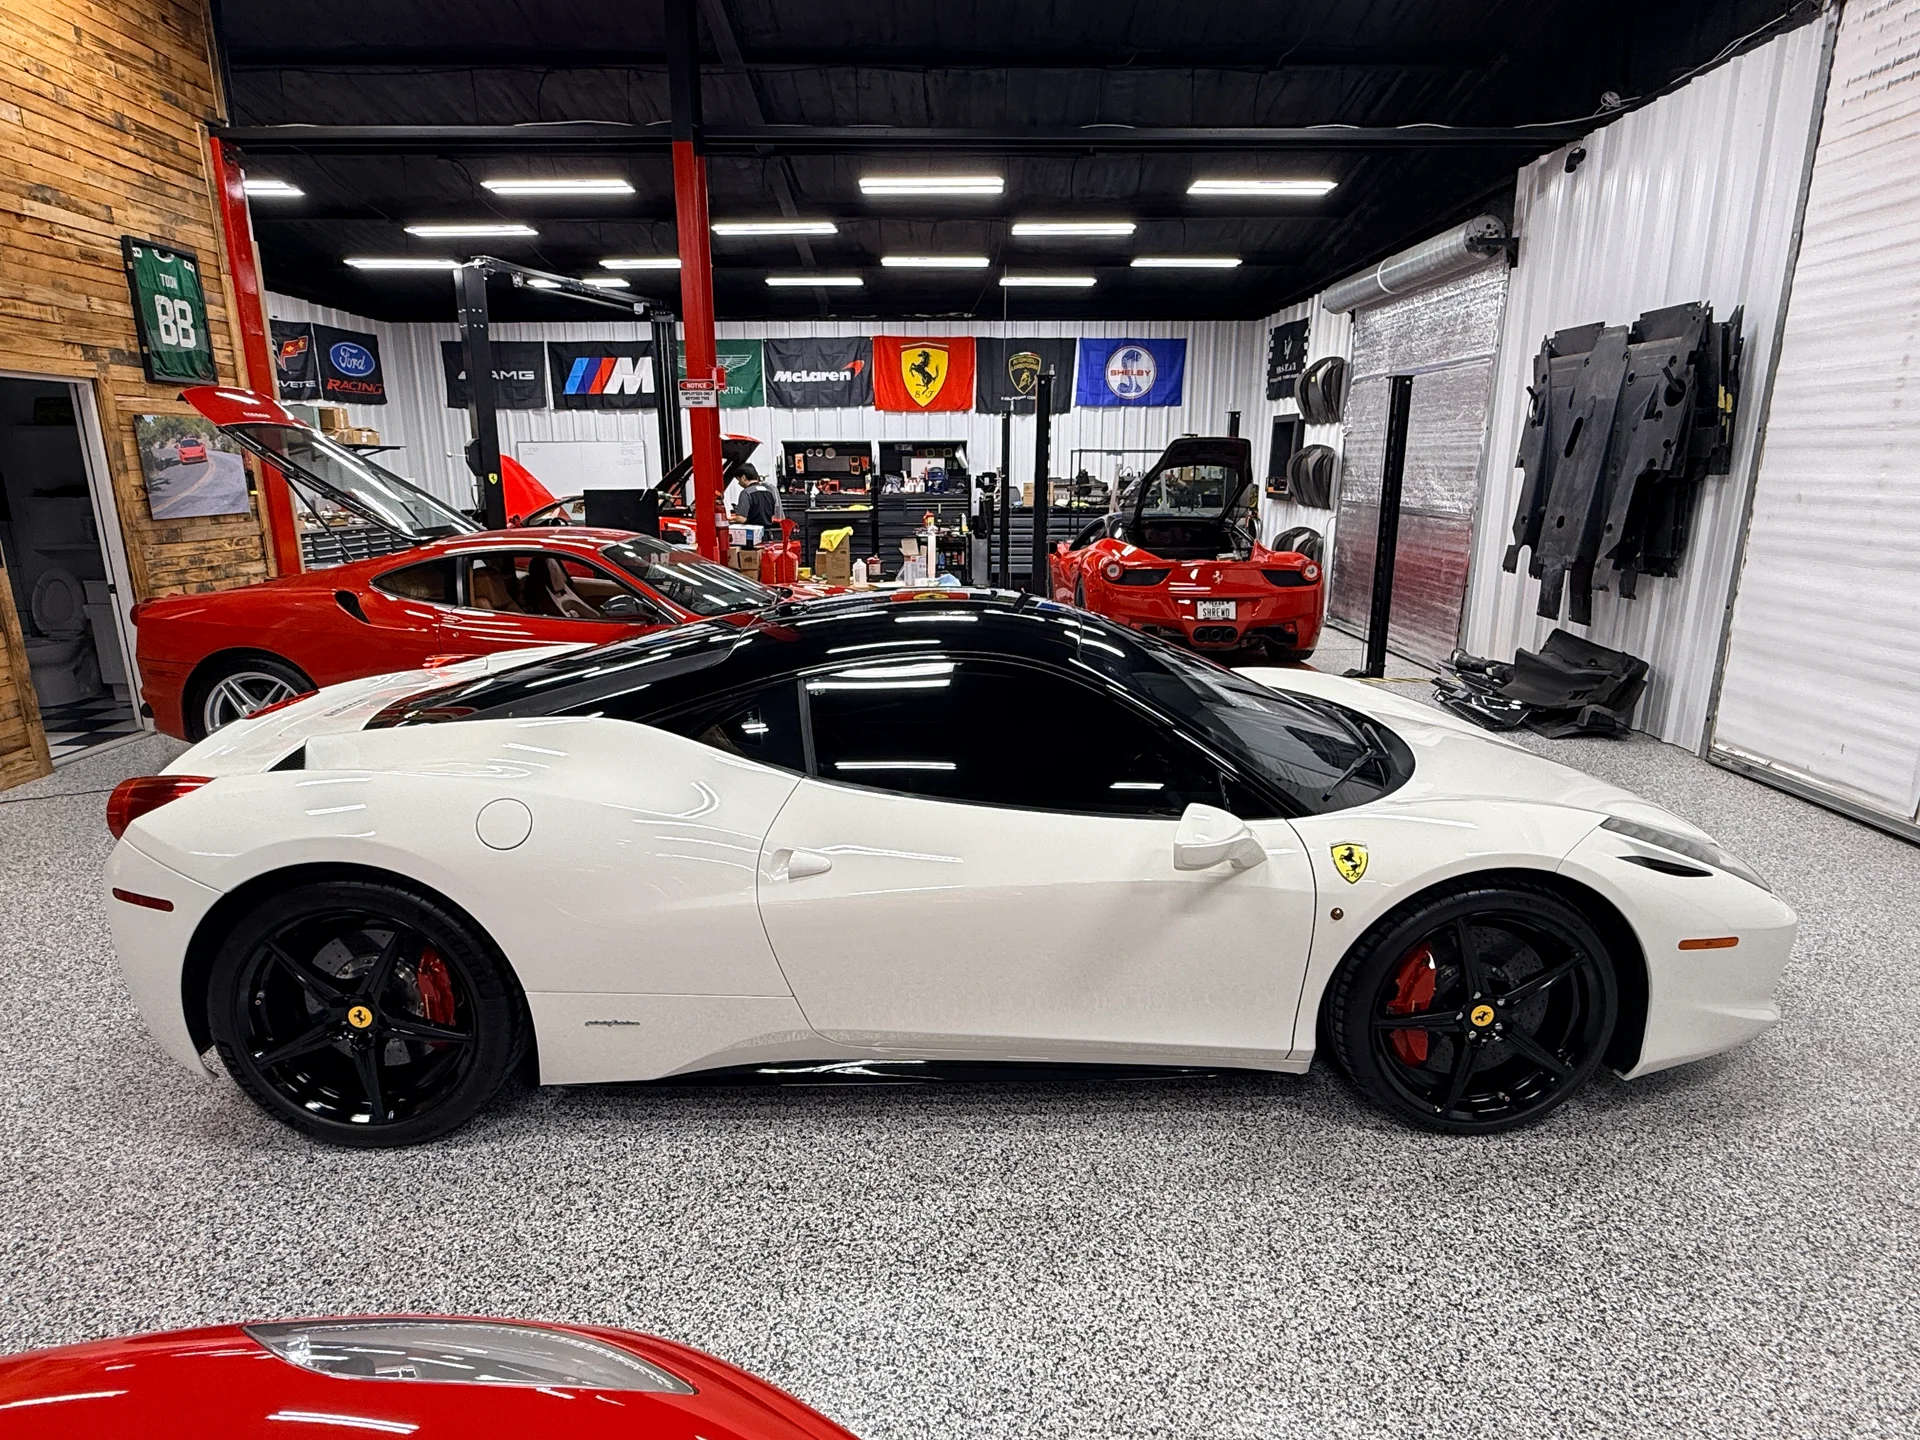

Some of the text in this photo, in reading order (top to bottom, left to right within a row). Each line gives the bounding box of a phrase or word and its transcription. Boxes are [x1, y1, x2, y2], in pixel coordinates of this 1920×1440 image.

[154, 294, 197, 349] 88
[340, 346, 366, 370] Ford
[603, 357, 655, 394] M
[773, 369, 852, 383] McLaren
[1110, 369, 1152, 377] SHELBY
[327, 377, 383, 395] RACING
[686, 381, 707, 389] NOTICE
[1202, 607, 1230, 617] SHREWD
